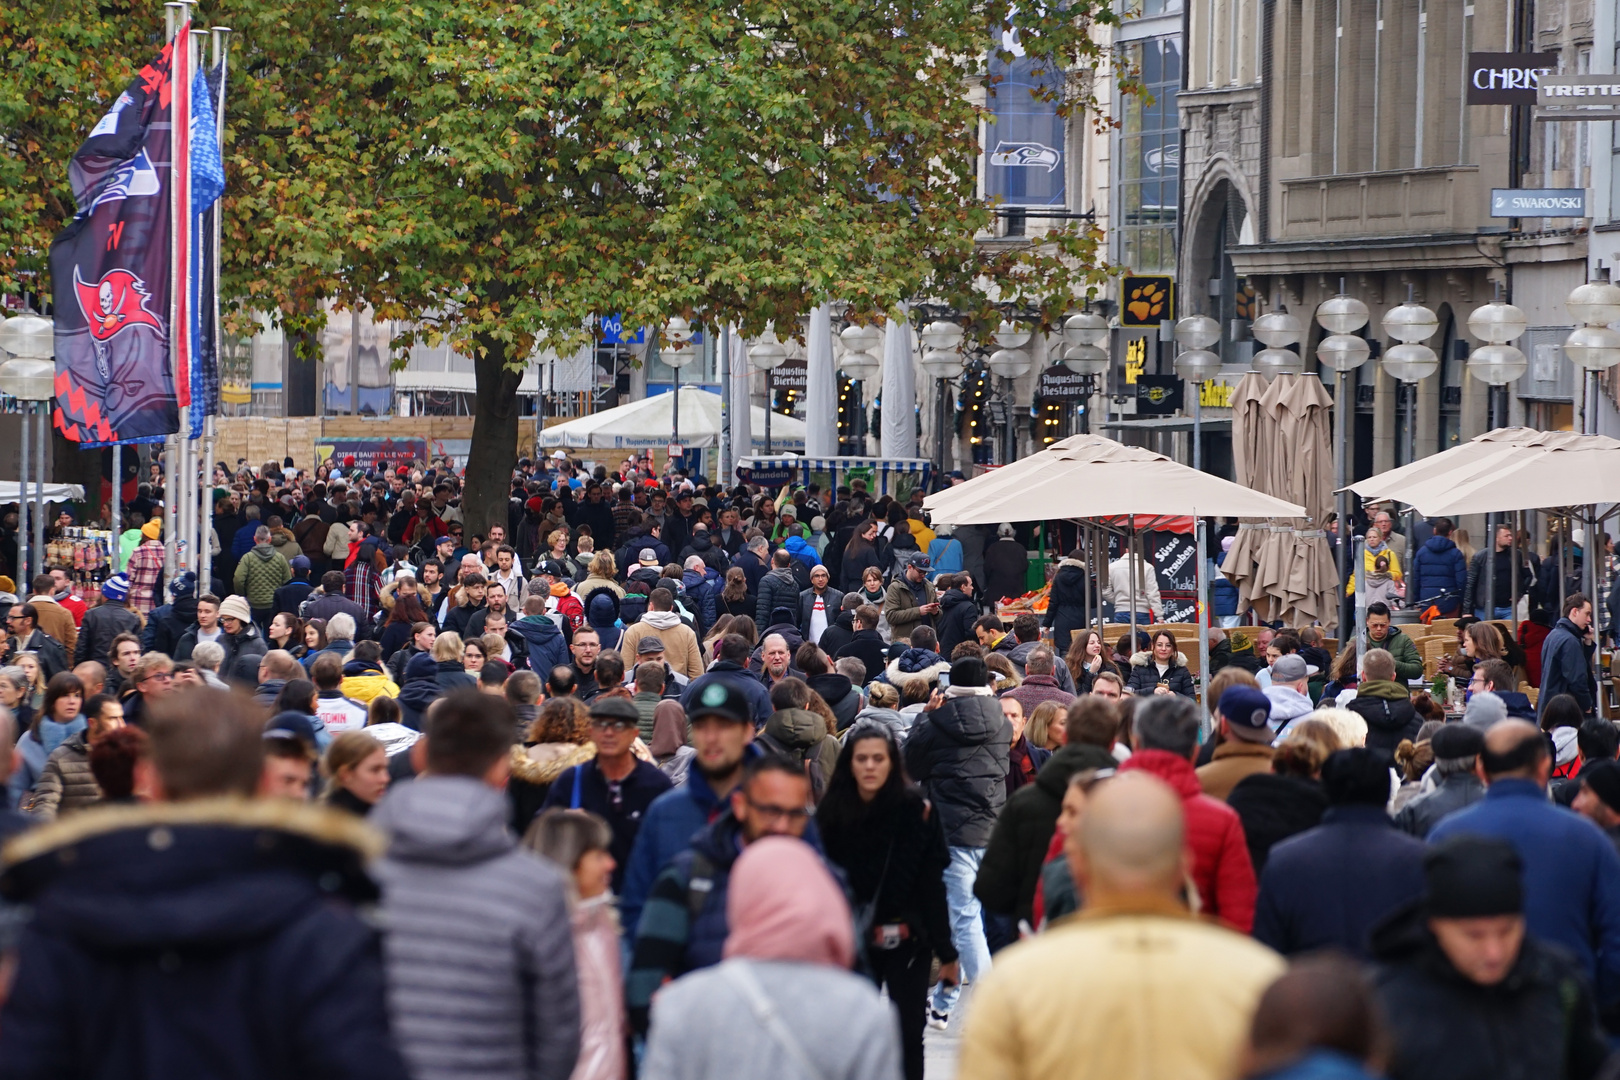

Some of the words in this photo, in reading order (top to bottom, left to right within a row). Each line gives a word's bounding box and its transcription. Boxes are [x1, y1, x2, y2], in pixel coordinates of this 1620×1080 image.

[1512, 197, 1581, 209] SWAROVSKI
[773, 376, 807, 386] Bierhall
[336, 451, 357, 459] DIESE
[358, 451, 396, 459] BAUSTELLE
[397, 451, 416, 459] WIRD
[1154, 537, 1180, 562] Süsse
[1161, 545, 1195, 577] Trauben
